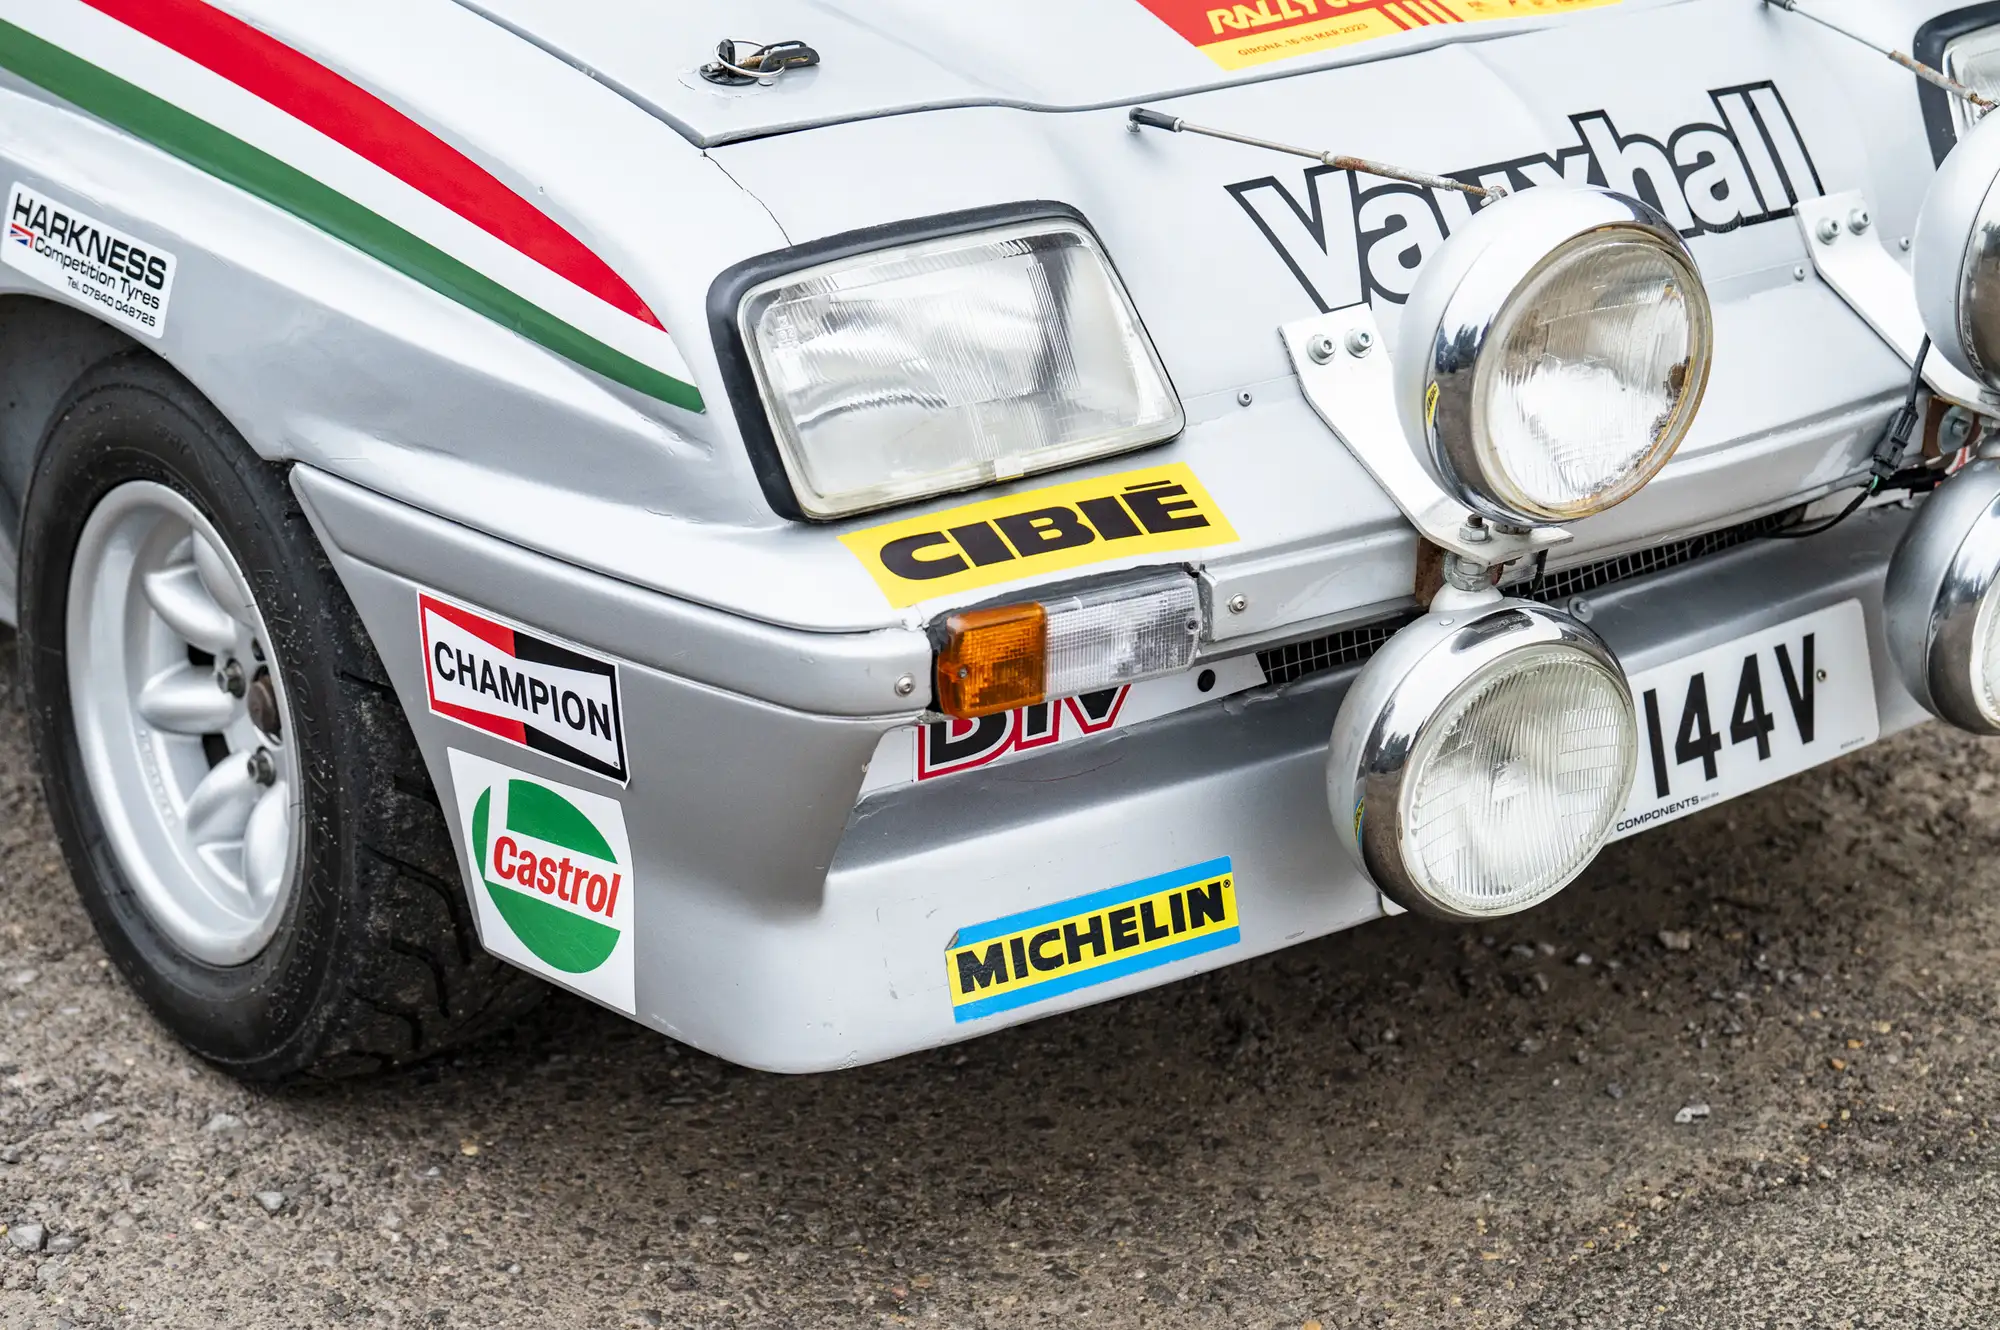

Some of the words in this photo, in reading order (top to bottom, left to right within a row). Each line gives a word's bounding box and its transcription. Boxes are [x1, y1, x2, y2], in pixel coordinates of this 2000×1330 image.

[1206, 0, 1318, 35] RALLY
[1314, 30, 1338, 39] MAR
[1340, 23, 1368, 33] 2023
[13, 192, 167, 291] HARKNESS
[34, 236, 116, 290] Competition
[121, 277, 160, 310] Tyres
[67, 275, 80, 291] Tel.
[82, 283, 114, 307] 07840
[115, 299, 156, 327] 048725
[434, 641, 612, 741] CHAMPION
[1616, 795, 1700, 832] COMPONENTS
[493, 836, 622, 918] Castrol
[956, 881, 1226, 995] MICHELIN
